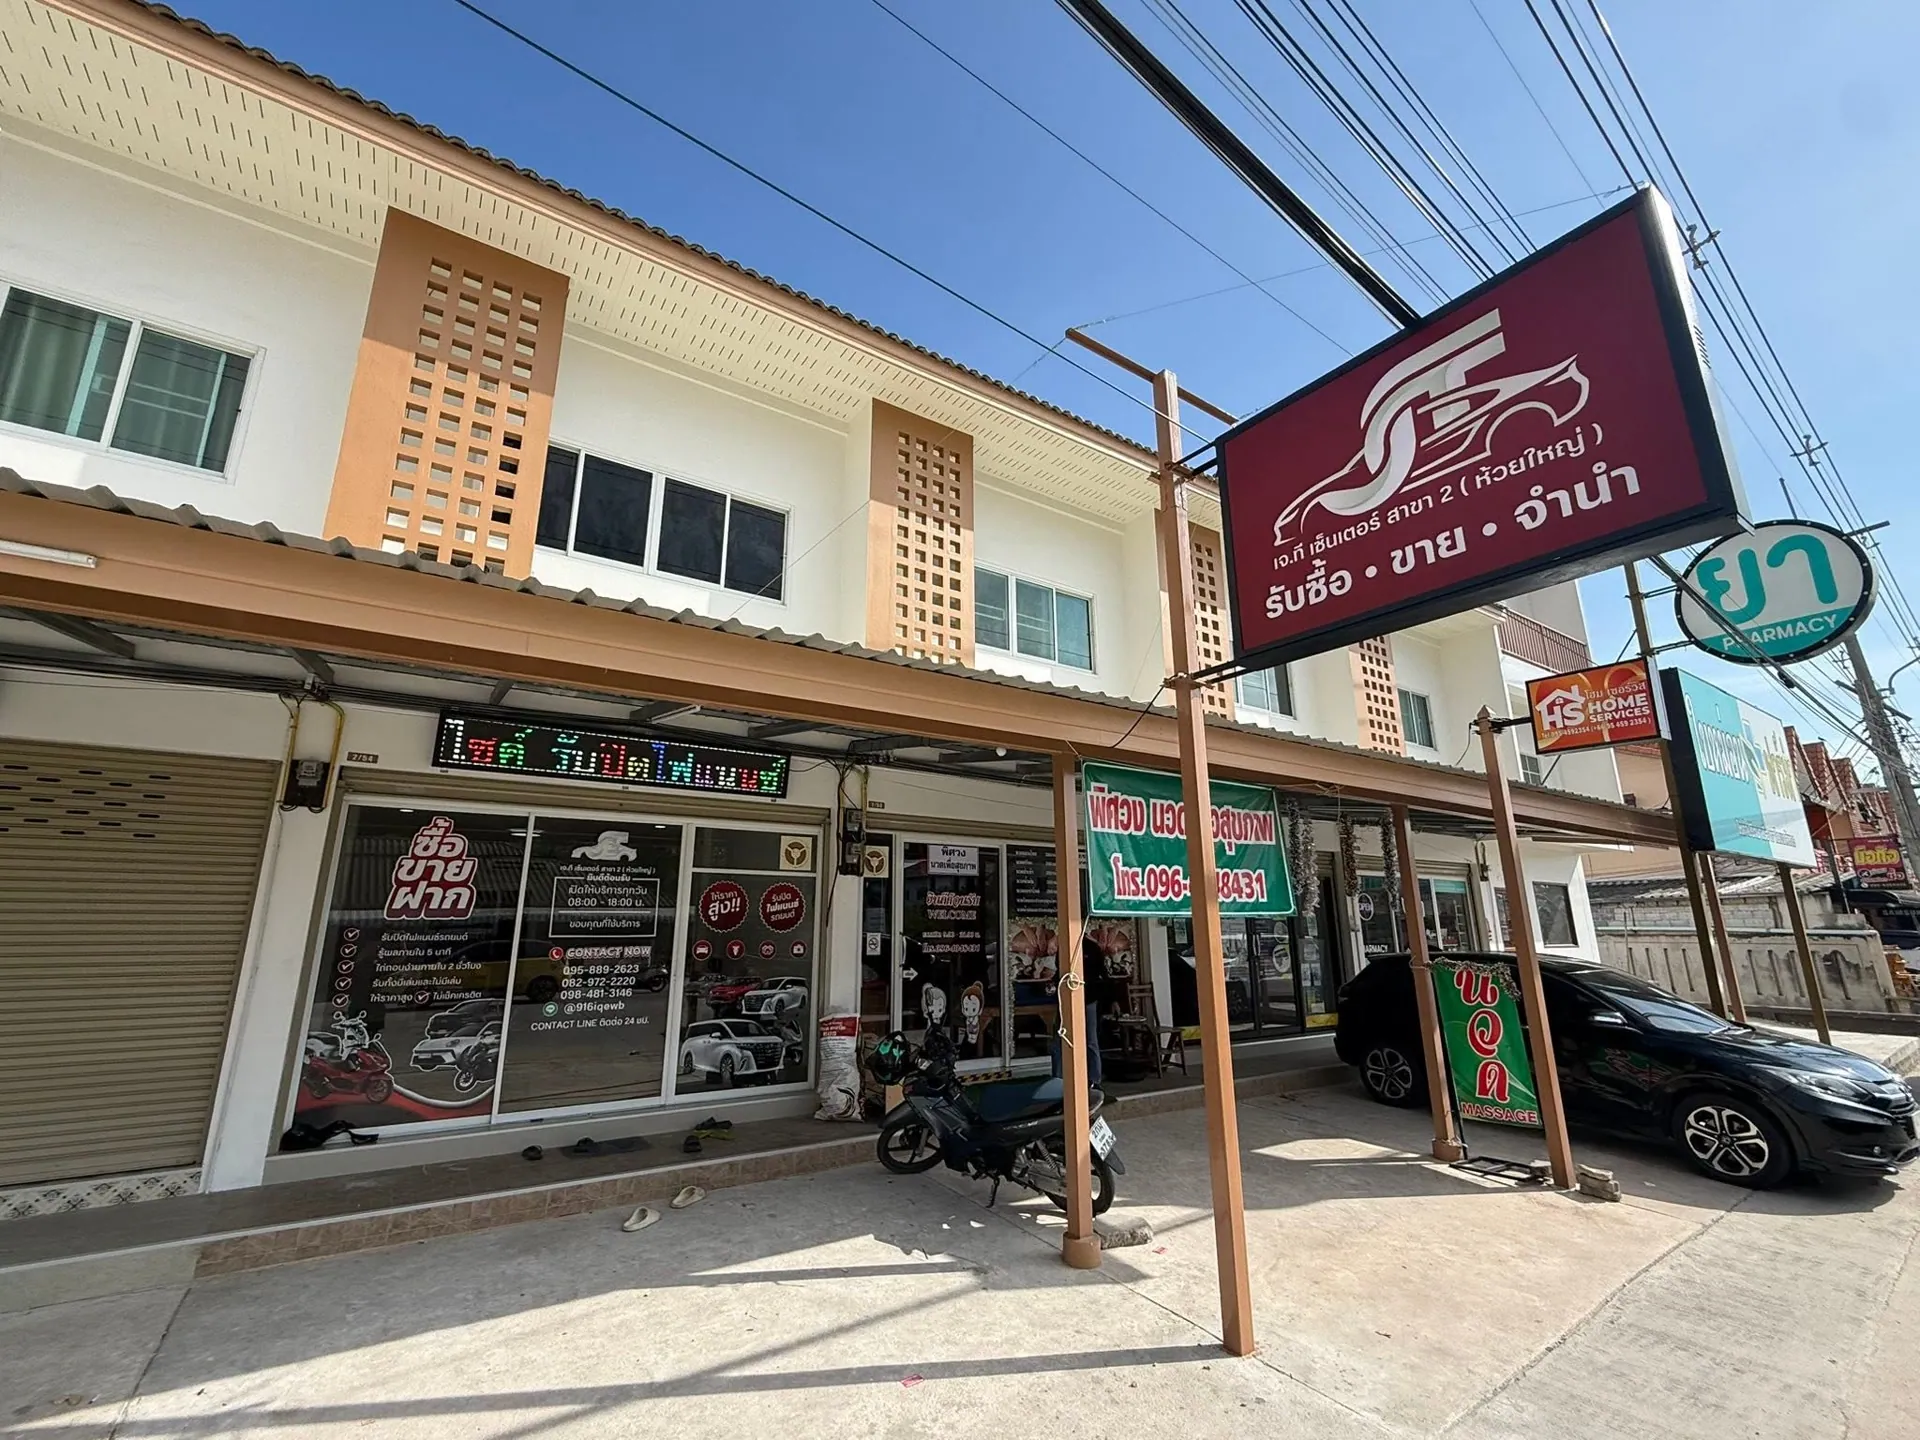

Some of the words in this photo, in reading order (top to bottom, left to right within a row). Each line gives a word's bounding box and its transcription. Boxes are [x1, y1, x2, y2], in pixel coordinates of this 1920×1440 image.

[1273, 543, 1305, 570] เจ.ที
[1310, 511, 1381, 555] เซ็นเตอร์
[1387, 495, 1433, 525] สาขา
[1440, 485, 1454, 503] 2
[1475, 427, 1586, 489] ห้วยใหญ่
[1265, 558, 1353, 619] รับซื้อ
[1390, 526, 1467, 575] ขาย
[1514, 461, 1641, 531] จำนำ
[1696, 534, 1838, 625] ยา
[1588, 693, 1649, 714] HOME
[1538, 702, 1585, 732] HS
[1590, 706, 1651, 723] SERVICES
[412, 818, 465, 858] ซื้อ
[396, 859, 475, 883] ขาย
[586, 872, 631, 882] ยินดีต้อนรับ
[1111, 854, 1266, 901] โทร.096-8431
[391, 880, 472, 910] ฝาก
[568, 884, 648, 897] เปิดให้บริการทุกวัน
[568, 897, 597, 907] 08:00
[607, 897, 633, 907] 18:00
[708, 897, 741, 921] สูง!!
[569, 917, 641, 931] ขอบคุณที่ใช้บริการ
[927, 909, 977, 920] WELCOME
[435, 946, 452, 956] นาที
[567, 946, 623, 959] CONTACT
[624, 945, 652, 958] NOW
[563, 964, 640, 975] 095-889-2623
[561, 976, 636, 988] 082-972-2220
[560, 988, 633, 1000] 098-481-3146
[531, 1019, 575, 1031] CONTACT
[576, 1018, 598, 1028] LINE
[624, 1016, 635, 1025] 24
[1454, 968, 1511, 1105] นวด
[1461, 1102, 1538, 1124] MASSAGE
